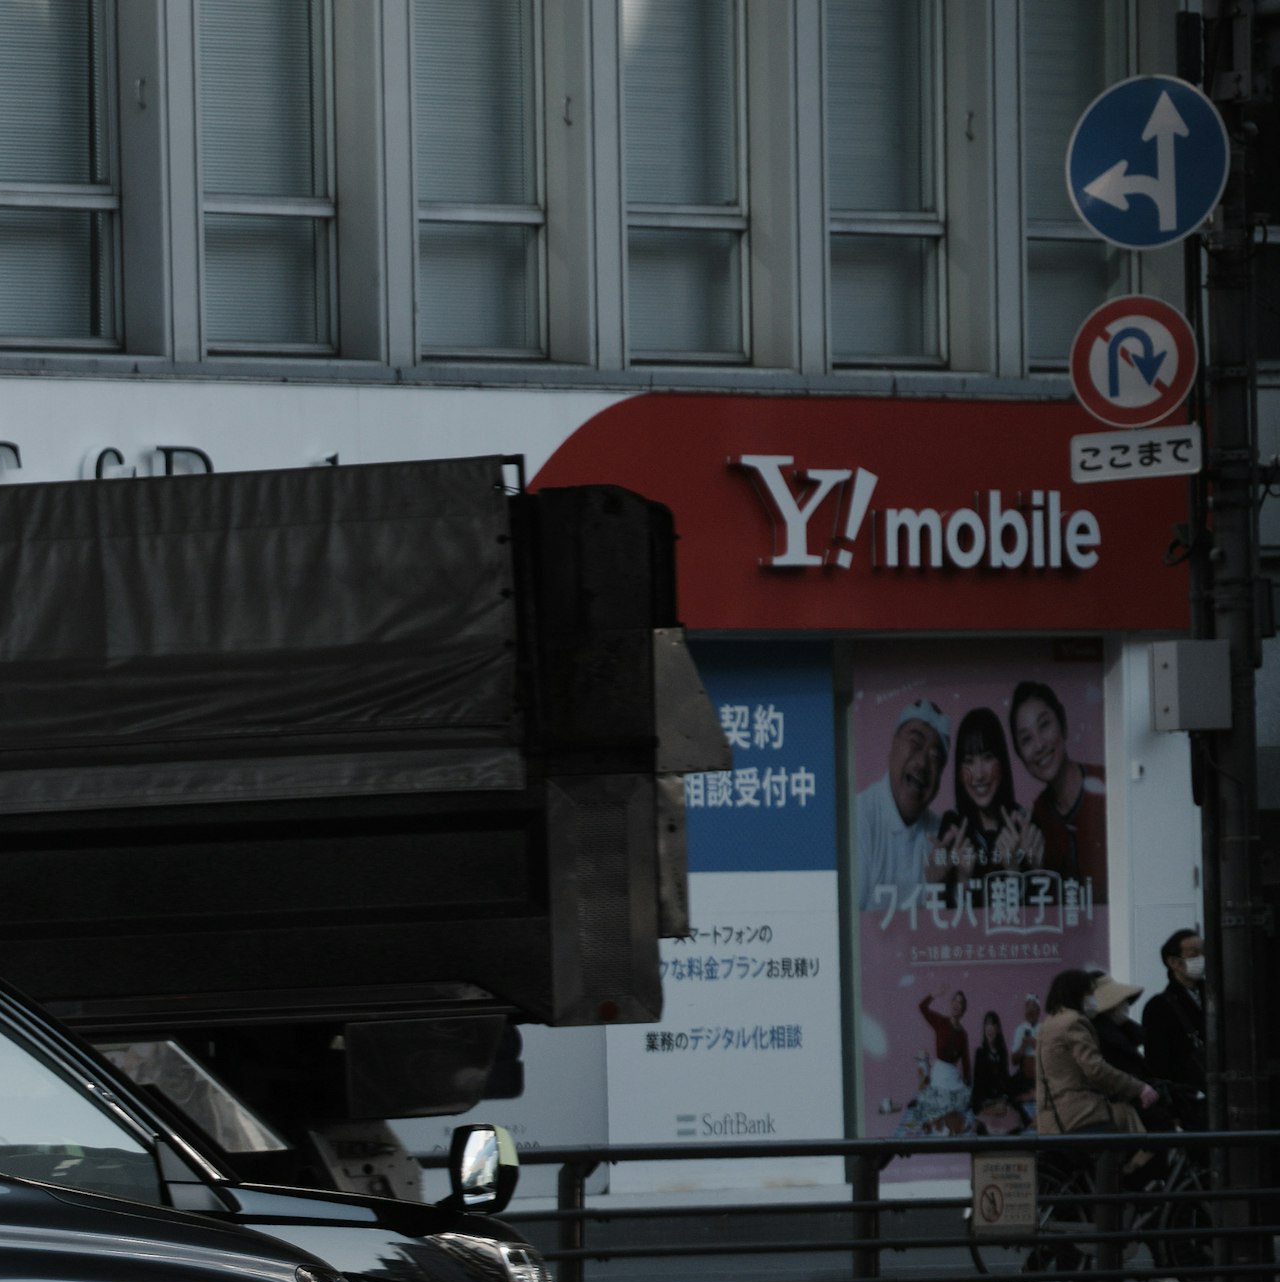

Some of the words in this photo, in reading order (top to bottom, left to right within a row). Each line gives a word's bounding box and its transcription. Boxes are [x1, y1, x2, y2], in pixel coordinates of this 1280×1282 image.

[1080, 438, 1193, 471] ここまで
[719, 703, 785, 750] 契約
[684, 766, 816, 808] 相談受付中
[646, 1024, 803, 1052] 業務のデジタル化相談
[702, 1112, 776, 1137] SoftBank
